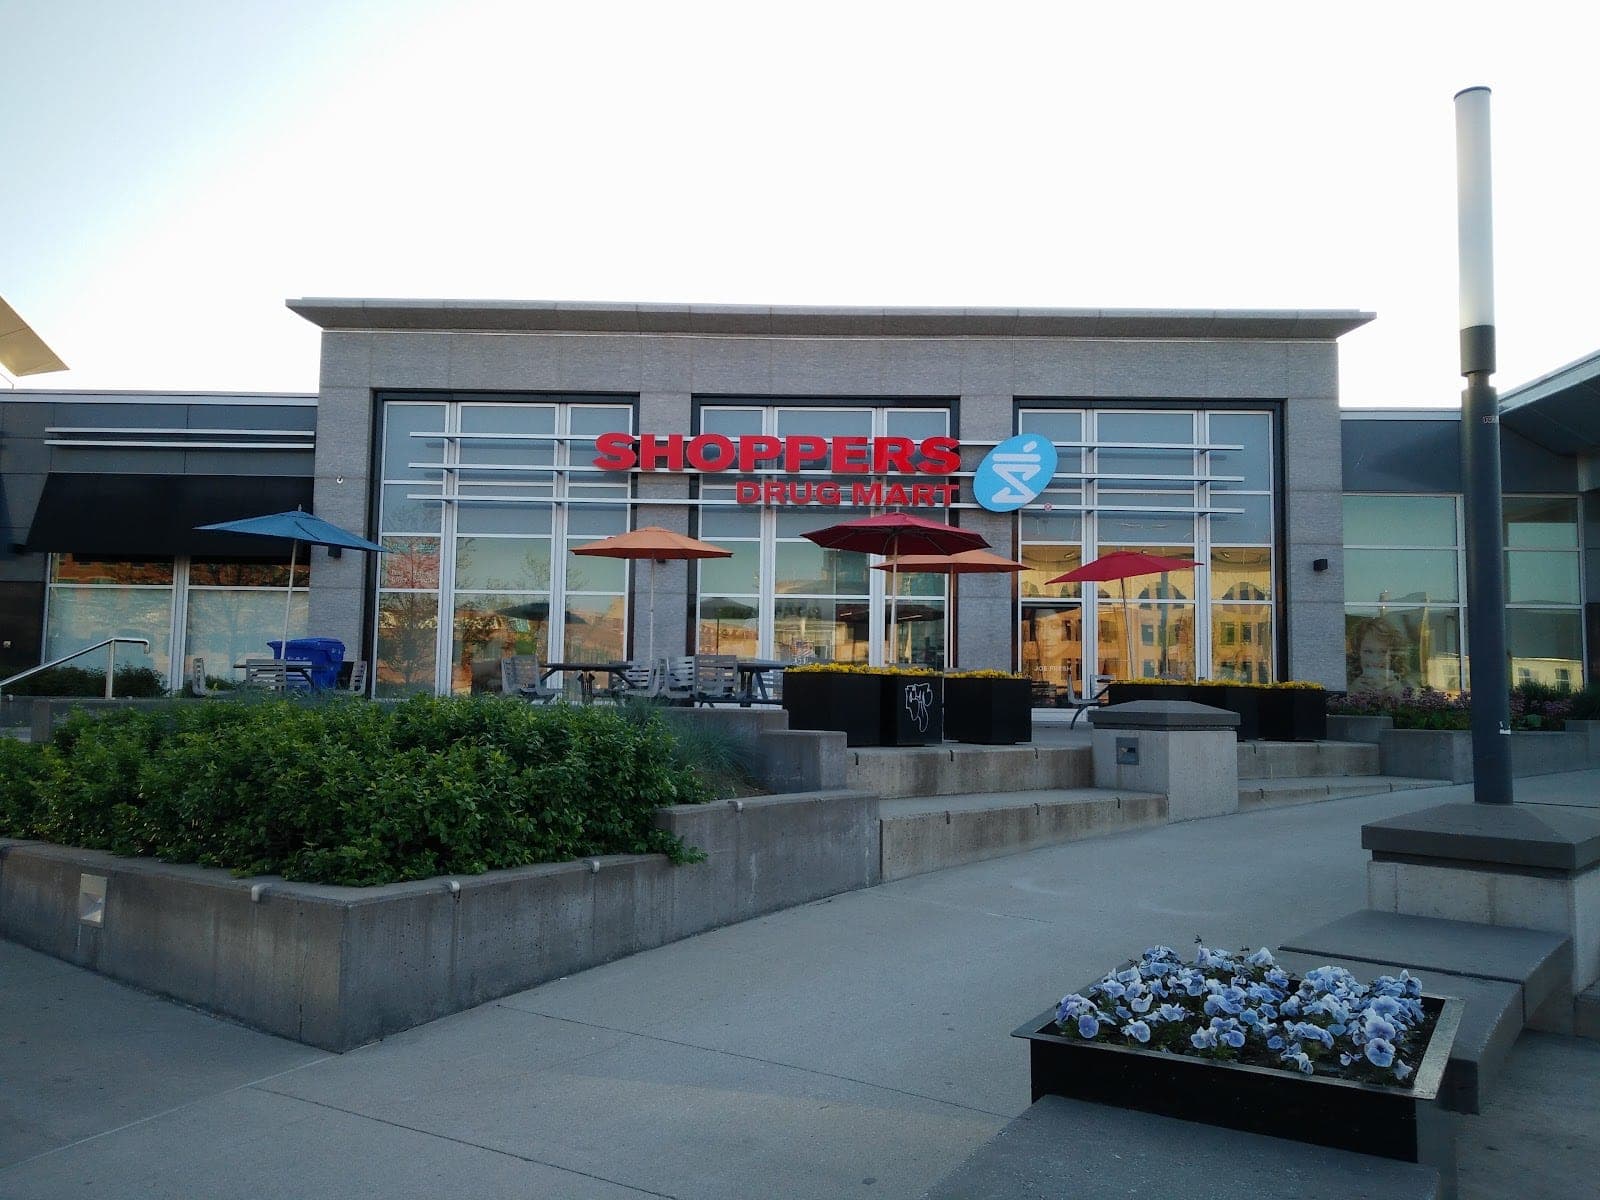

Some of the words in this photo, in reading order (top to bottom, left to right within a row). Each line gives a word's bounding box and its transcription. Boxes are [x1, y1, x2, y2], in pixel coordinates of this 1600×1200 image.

[592, 432, 961, 474] SHOPPERS
[735, 481, 841, 505] DRUG
[852, 483, 960, 507] MART
